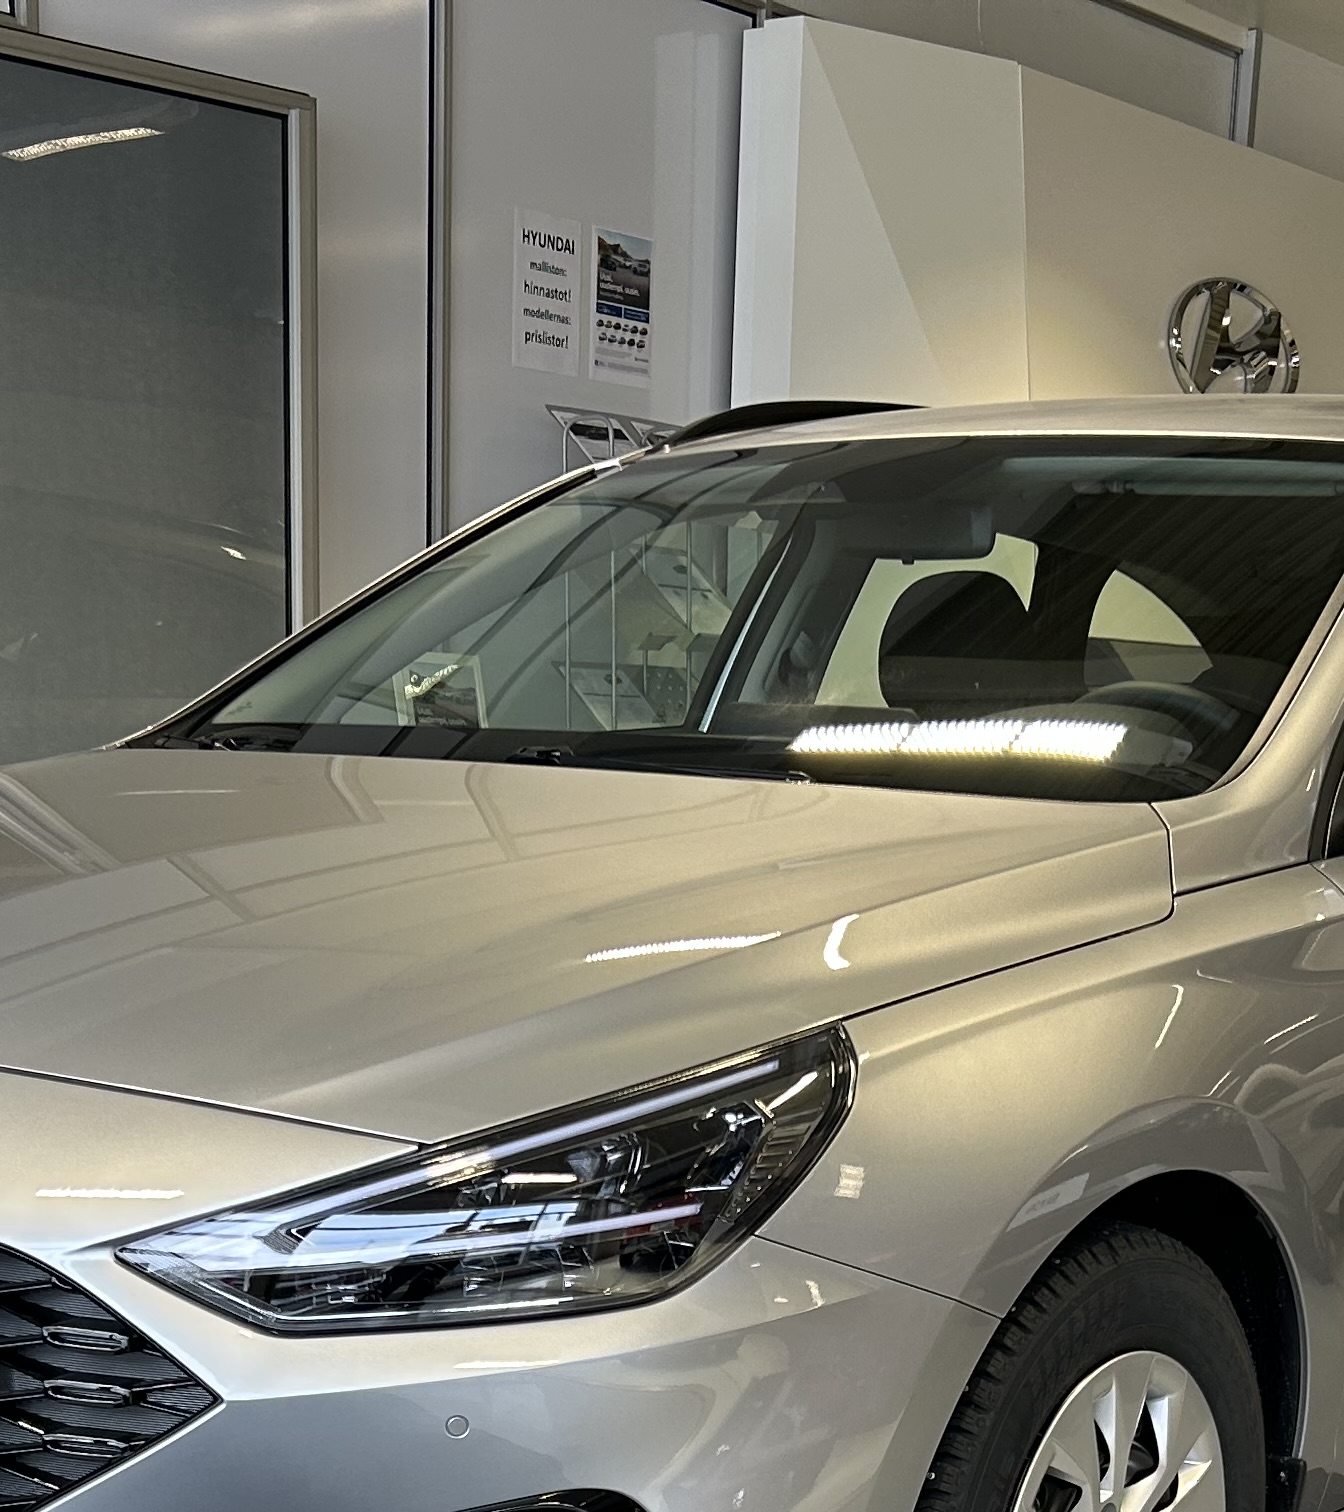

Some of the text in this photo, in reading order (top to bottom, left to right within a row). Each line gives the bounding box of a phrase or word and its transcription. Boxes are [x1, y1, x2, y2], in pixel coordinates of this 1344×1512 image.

[522, 228, 575, 255] HYUNDAI
[523, 279, 572, 303] hinnastot!
[524, 330, 569, 349] prislistor!
